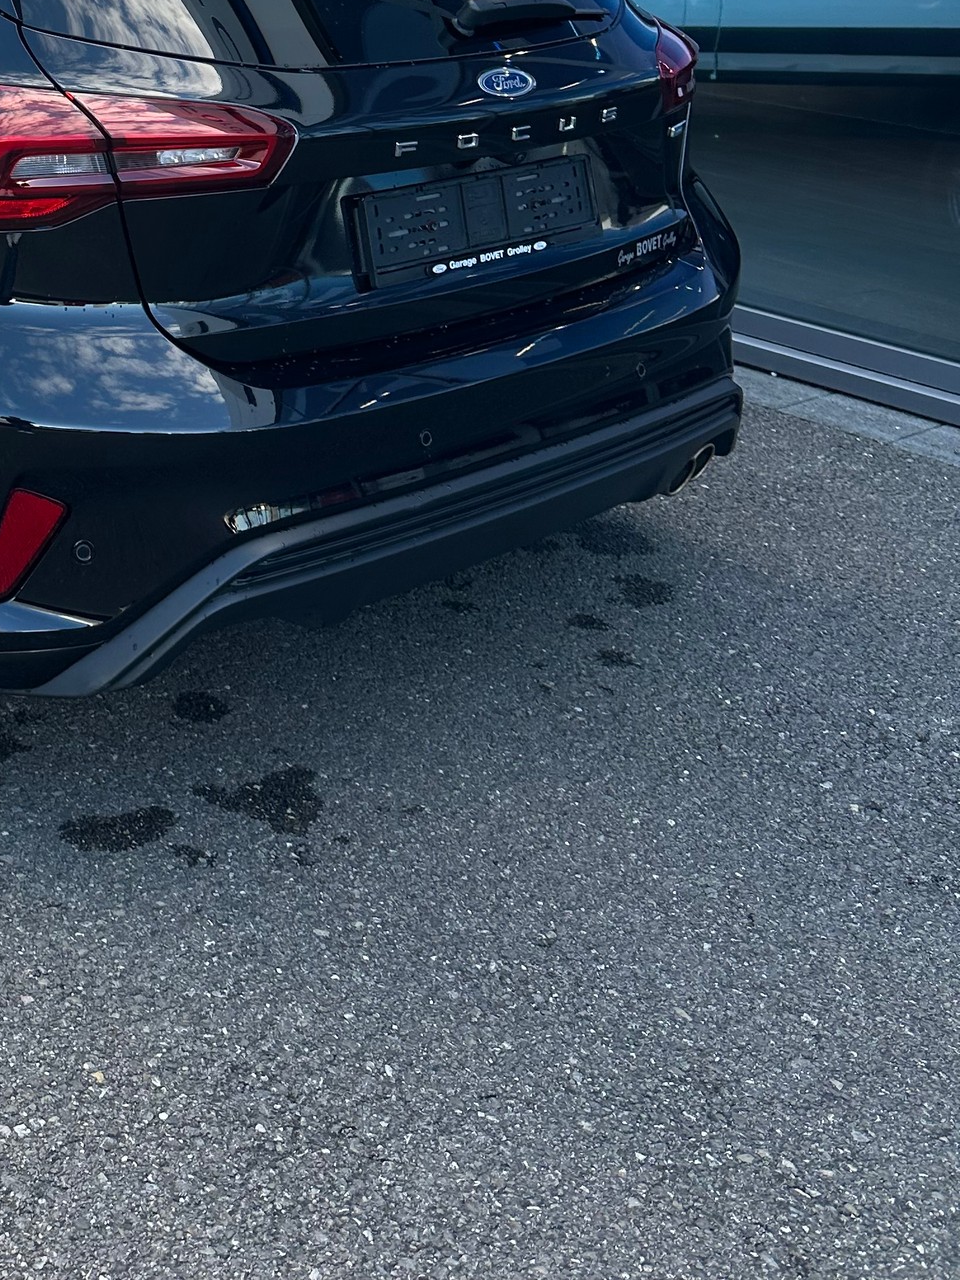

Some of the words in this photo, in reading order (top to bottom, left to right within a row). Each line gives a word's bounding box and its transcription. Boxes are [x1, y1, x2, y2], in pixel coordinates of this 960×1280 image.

[492, 74, 526, 91] Ford
[395, 107, 617, 157] FOCUS
[449, 257, 477, 269] Garage
[480, 250, 505, 262] BOVET
[507, 244, 532, 257] Grolley
[636, 234, 662, 256] BOVET
